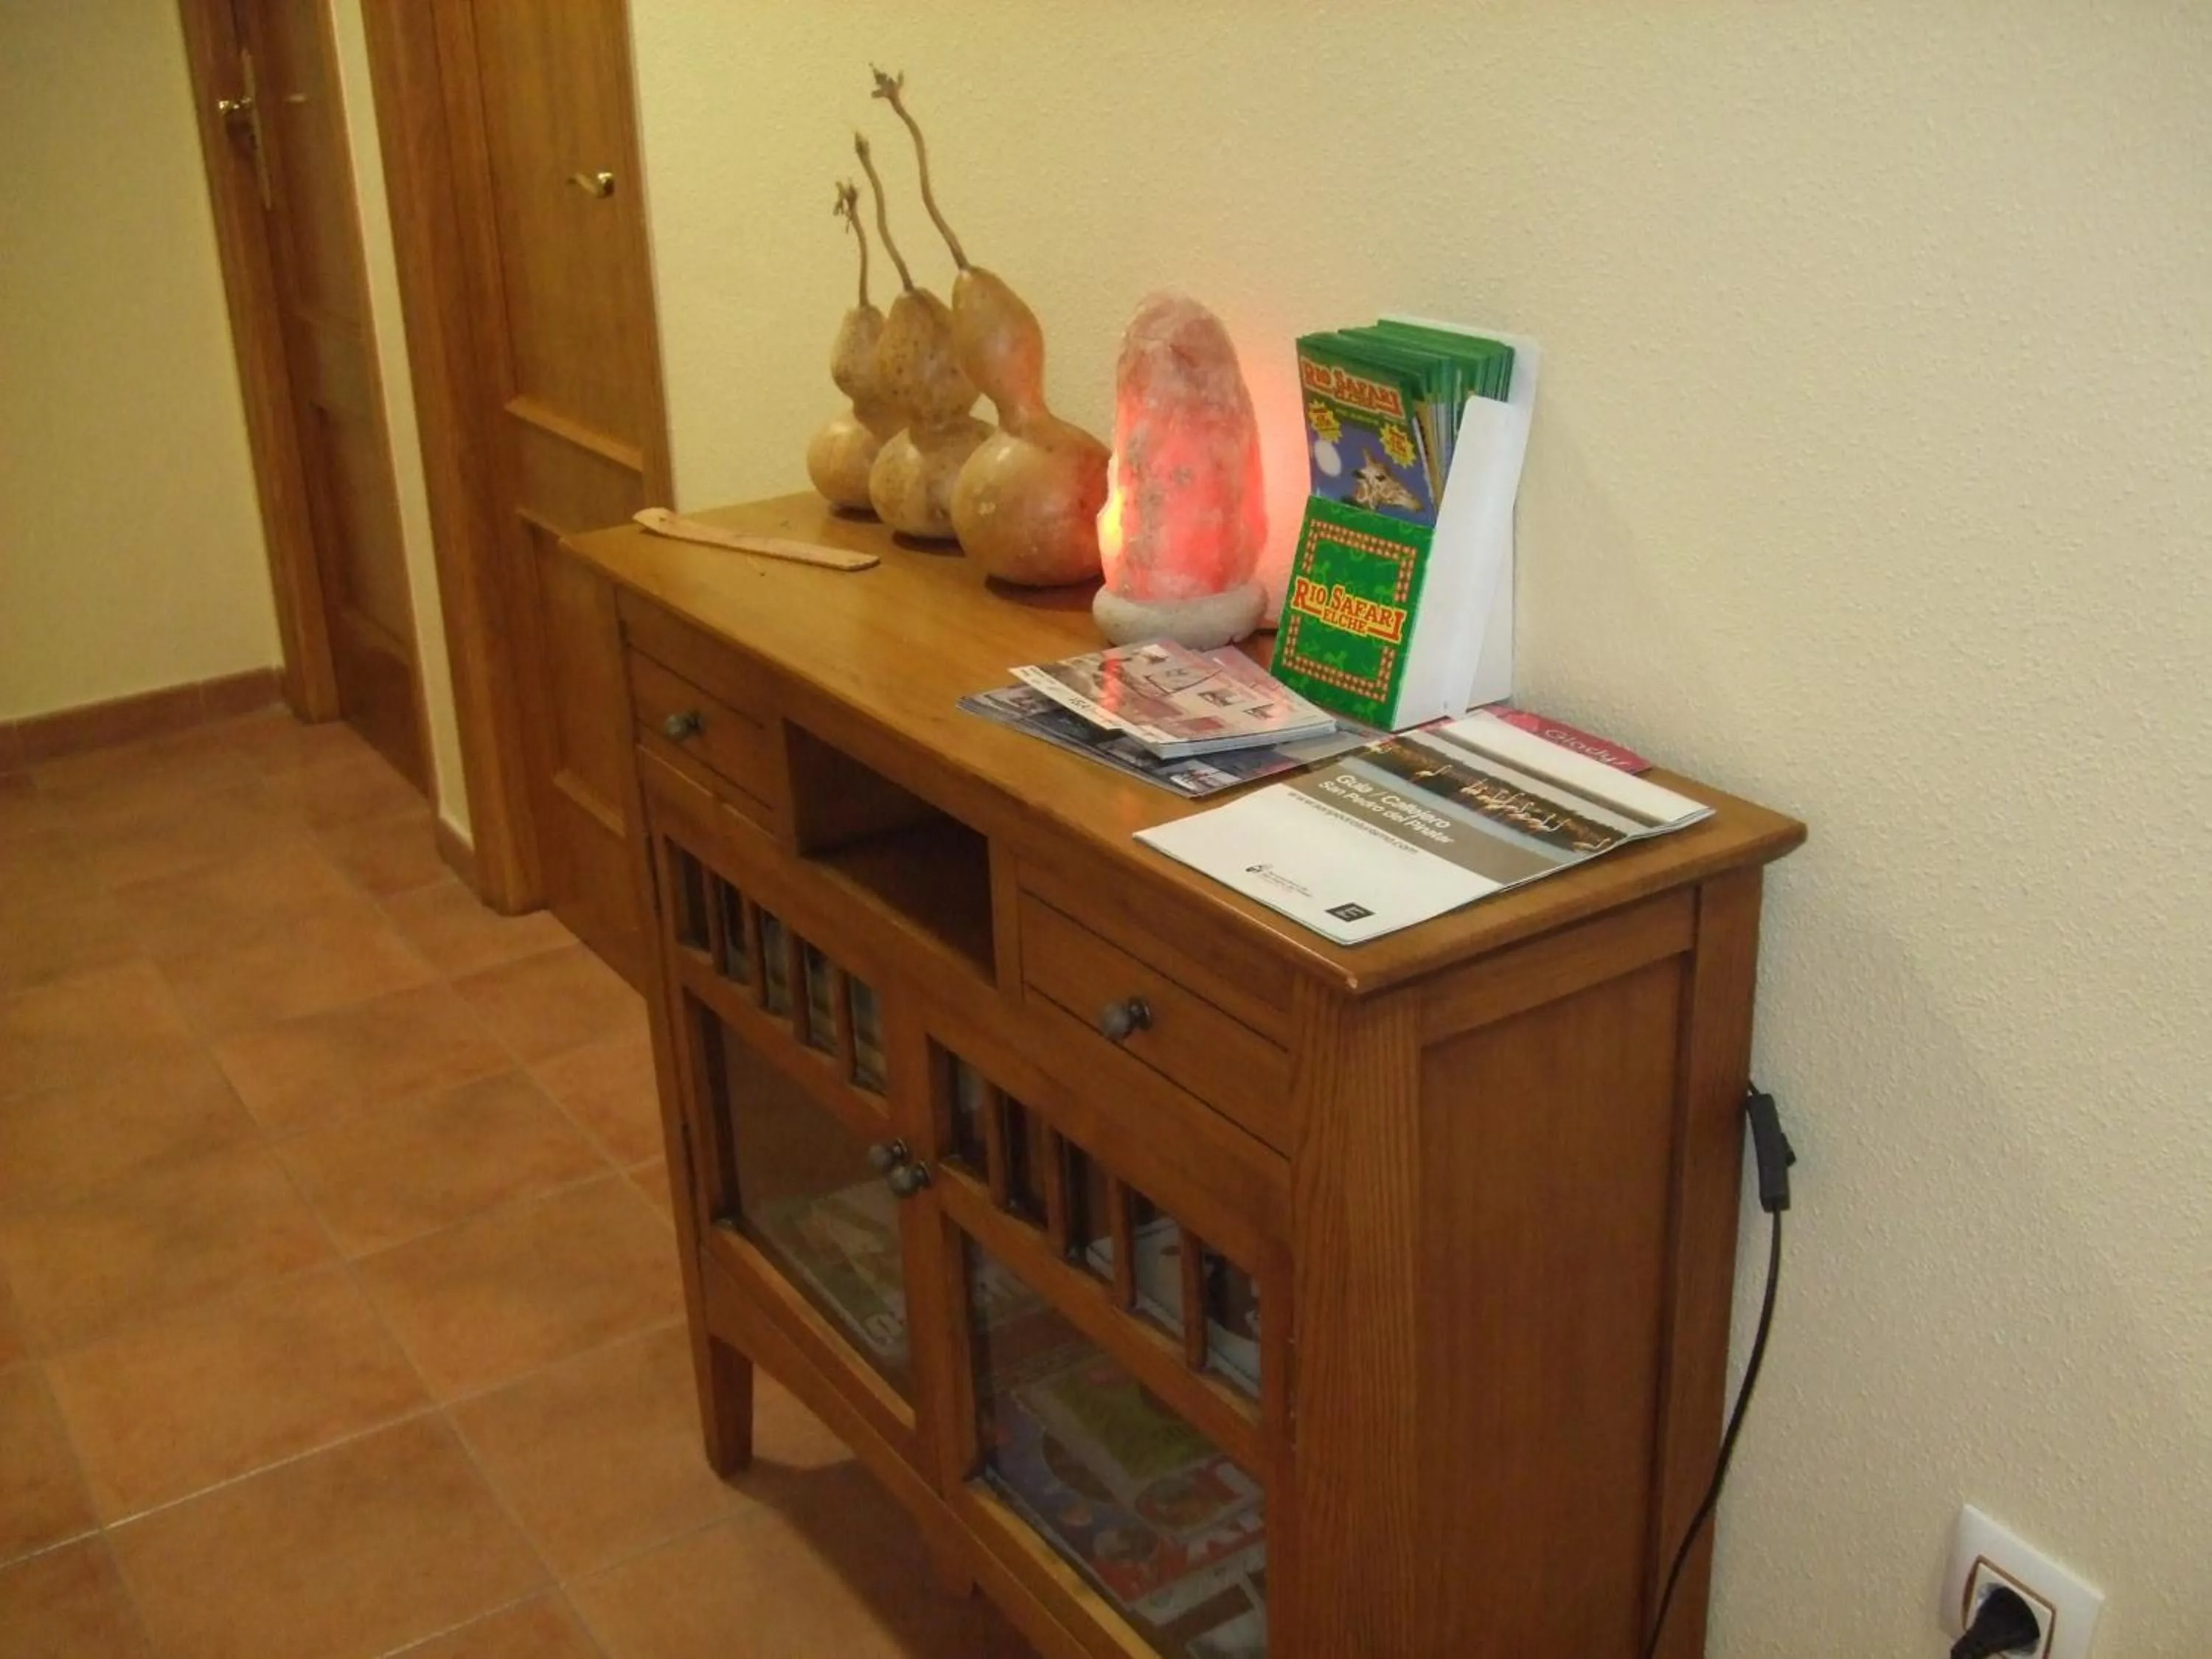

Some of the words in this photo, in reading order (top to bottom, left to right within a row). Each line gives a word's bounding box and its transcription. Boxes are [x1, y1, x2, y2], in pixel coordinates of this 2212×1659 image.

[1293, 577, 1328, 610] RIO
[1330, 587, 1405, 641] SAFARI
[1322, 609, 1369, 636] ELCHE
[1318, 781, 1346, 796] San
